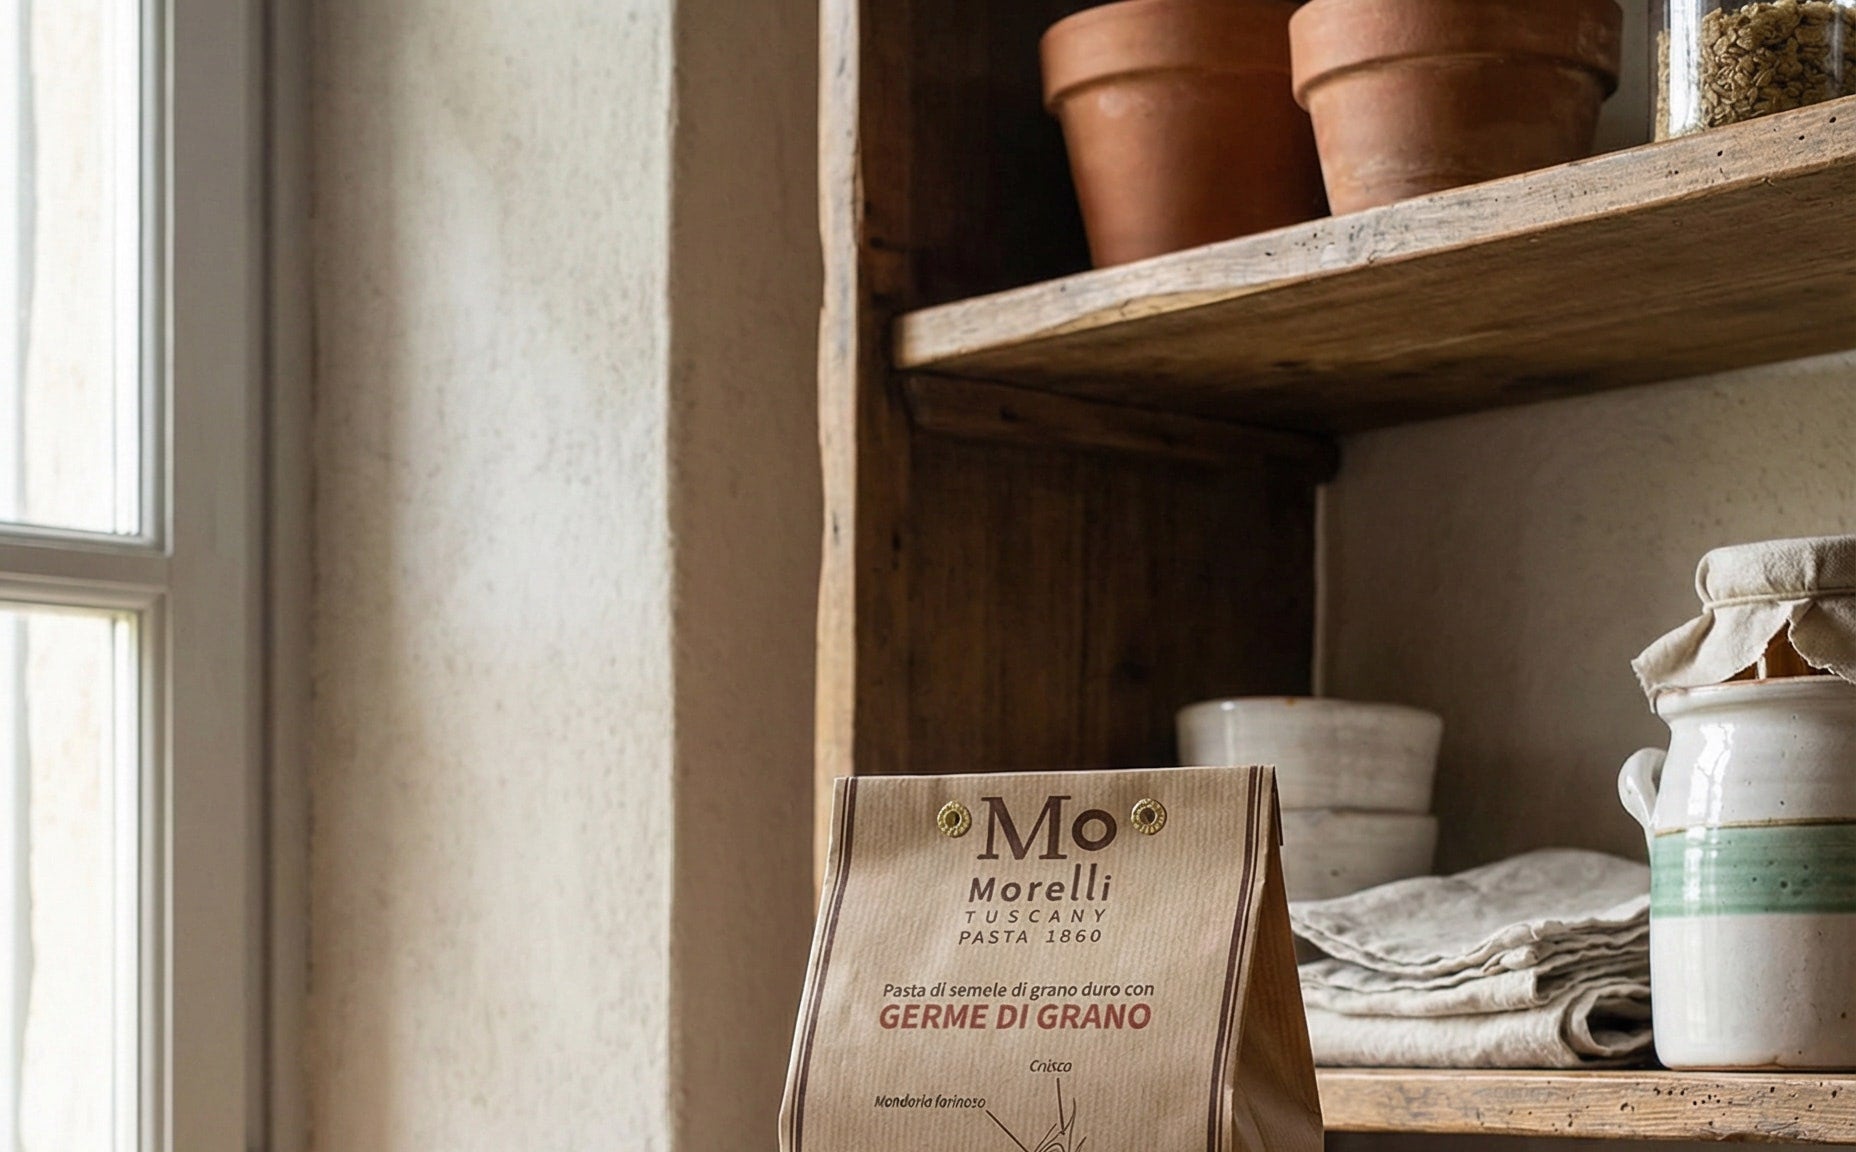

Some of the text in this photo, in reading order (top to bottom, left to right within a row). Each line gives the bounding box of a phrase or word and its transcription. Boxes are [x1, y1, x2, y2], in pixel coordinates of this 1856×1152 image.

[977, 795, 1117, 860] Mo
[968, 863, 1111, 902] Morelli
[965, 909, 1107, 924] TUSCANY
[959, 929, 1102, 945] PASTA 1860
[883, 984, 926, 997] Pasta
[949, 983, 1006, 997] semele
[1012, 982, 1027, 997] di
[1029, 984, 1078, 1000] grano
[1081, 981, 1121, 996] duro
[1124, 984, 1154, 996] con
[879, 1003, 1152, 1029] GERME DI GRANO
